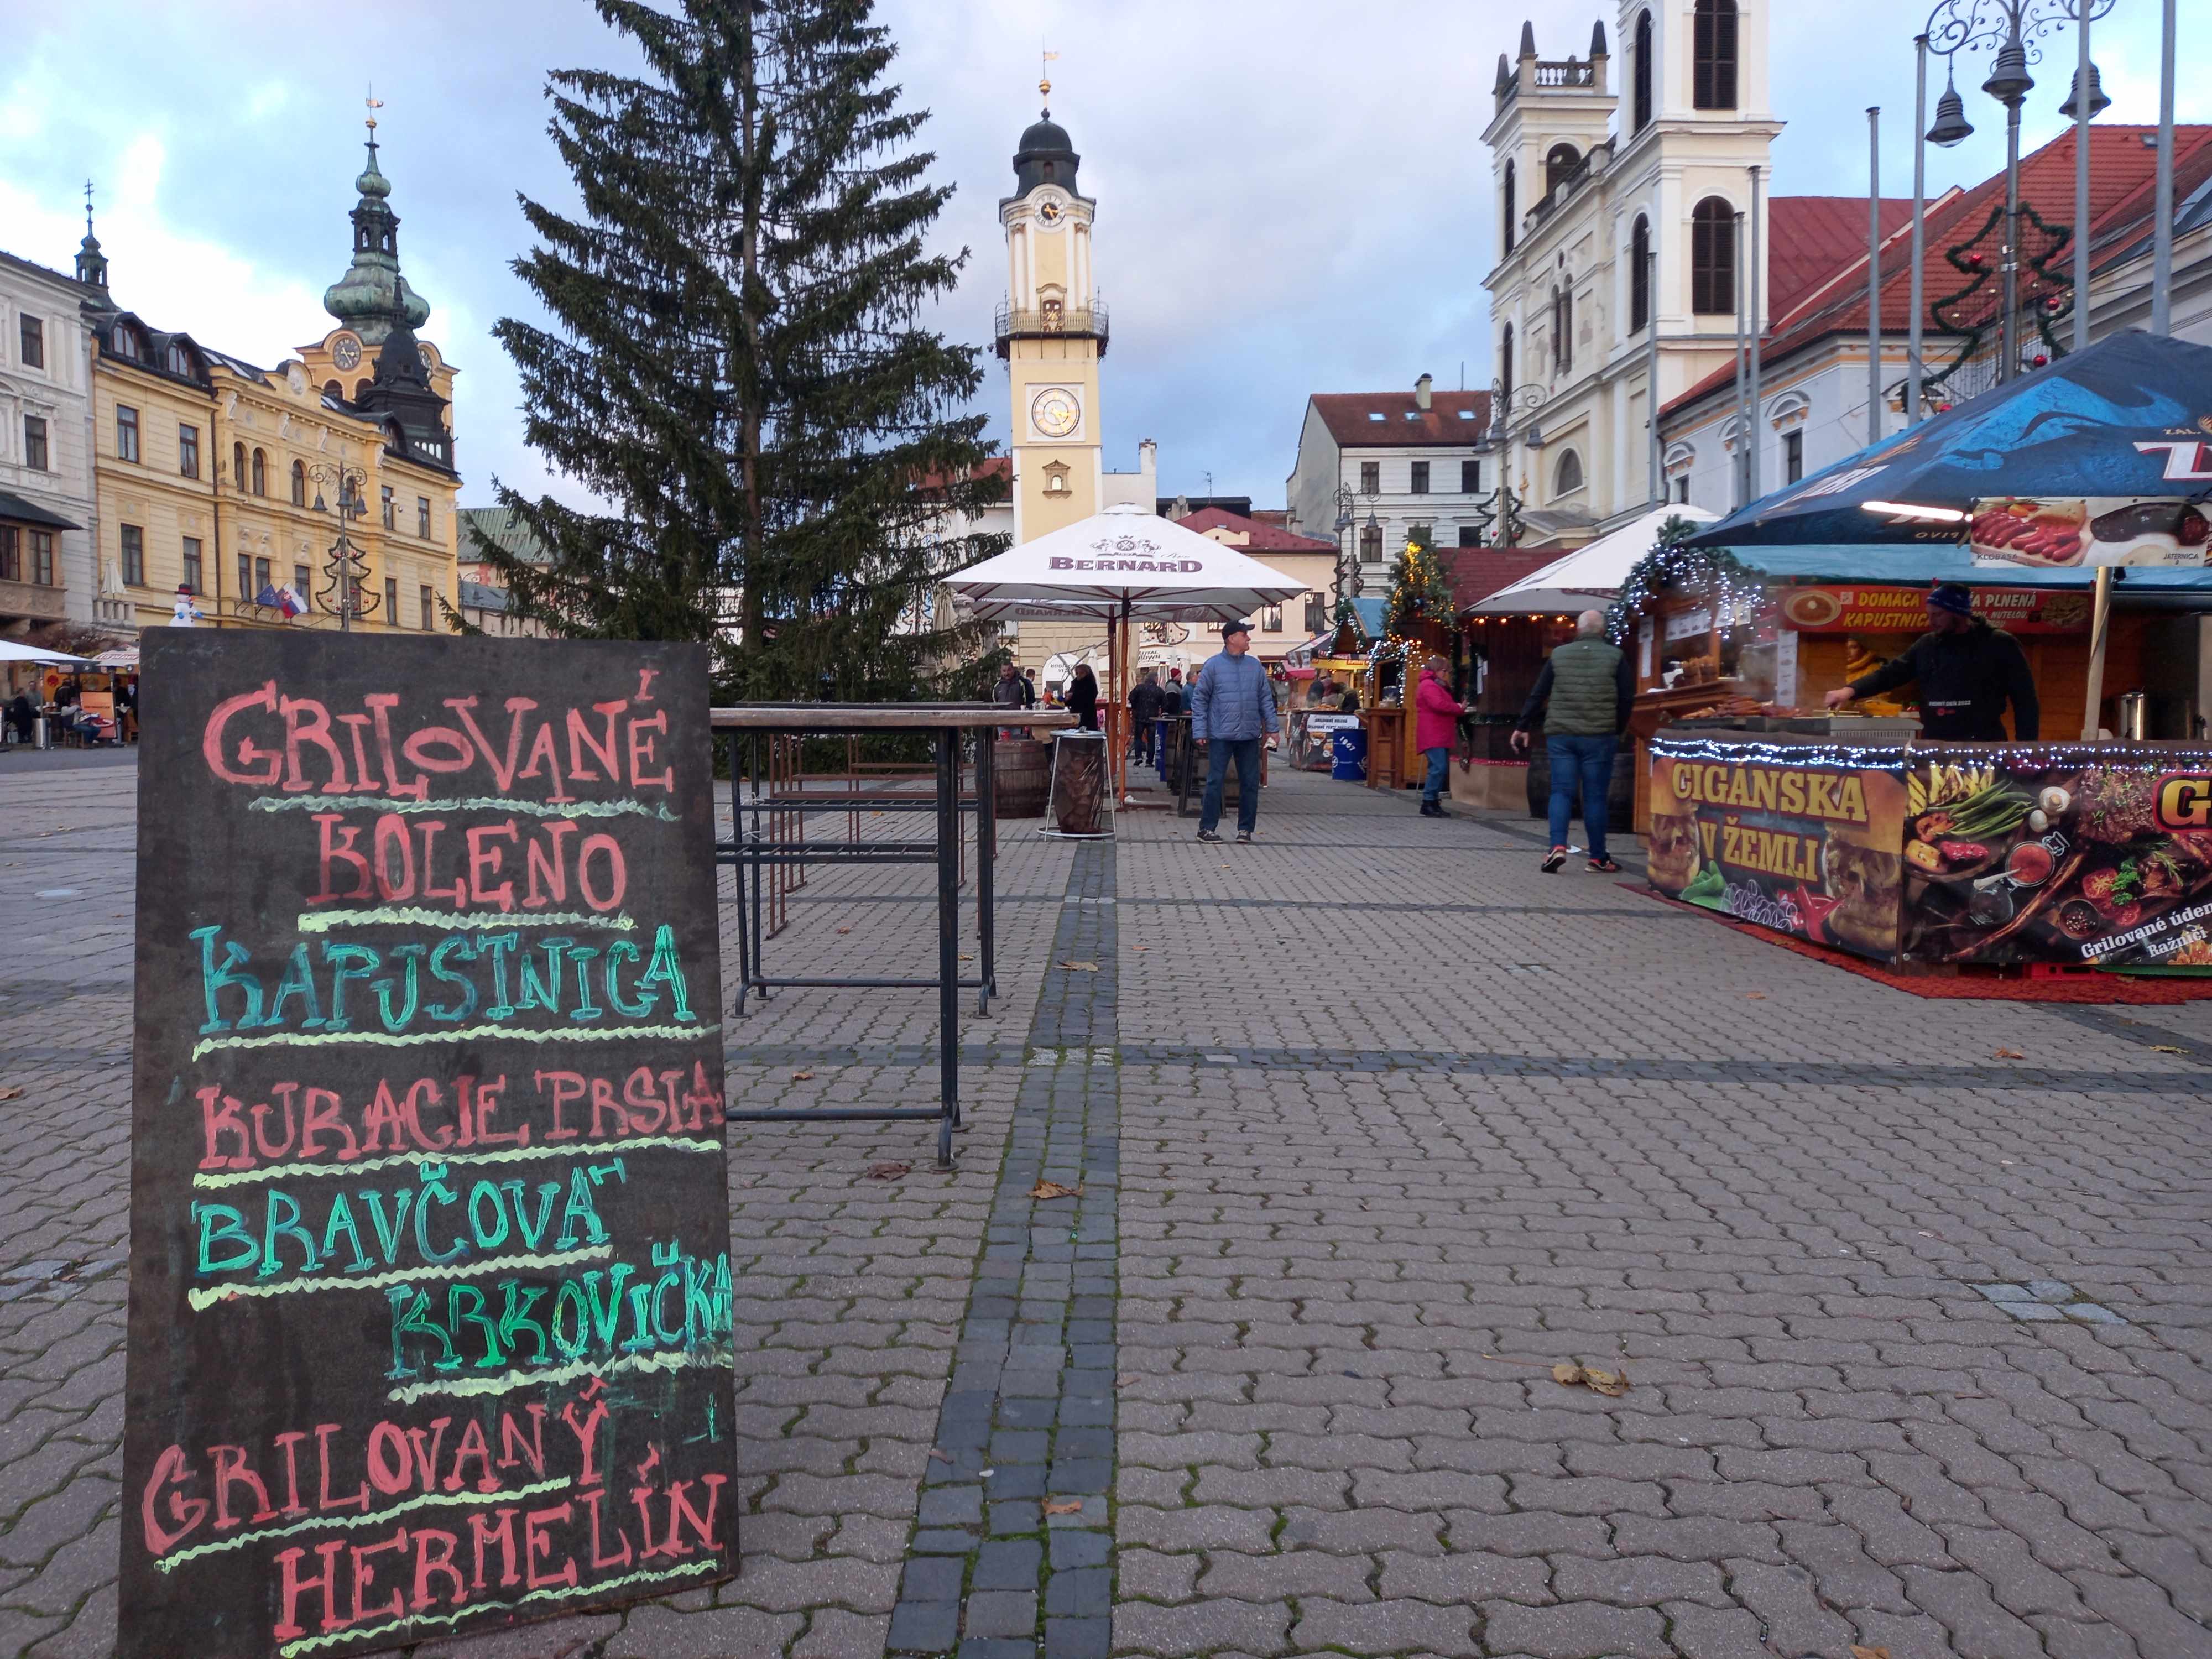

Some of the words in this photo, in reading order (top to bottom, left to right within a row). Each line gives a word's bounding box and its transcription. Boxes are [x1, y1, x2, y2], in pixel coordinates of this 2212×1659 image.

[1049, 556, 1203, 573] BERNARD
[1858, 589, 1919, 607] DOMÁCA
[1985, 591, 2036, 607] PLNENÁ
[1843, 612, 1929, 628] KAPUSTNIC
[202, 668, 674, 802] GRILOVANÉ
[1672, 761, 1868, 822] CIGÁNSKA
[305, 813, 627, 911] KOLENO
[1700, 822, 1717, 859] V
[1723, 817, 1819, 881] ŽEMLI
[188, 924, 698, 1034] KAPUSTNICA
[2081, 917, 2167, 958] Grilované
[197, 1073, 528, 1170] KURACIE
[191, 1157, 627, 1277] BRAVČOVÁ
[383, 1240, 732, 1377] KRKOVIČKA
[142, 1377, 608, 1555] GRILOVANÝ
[273, 1440, 728, 1641] HERMELÍN
